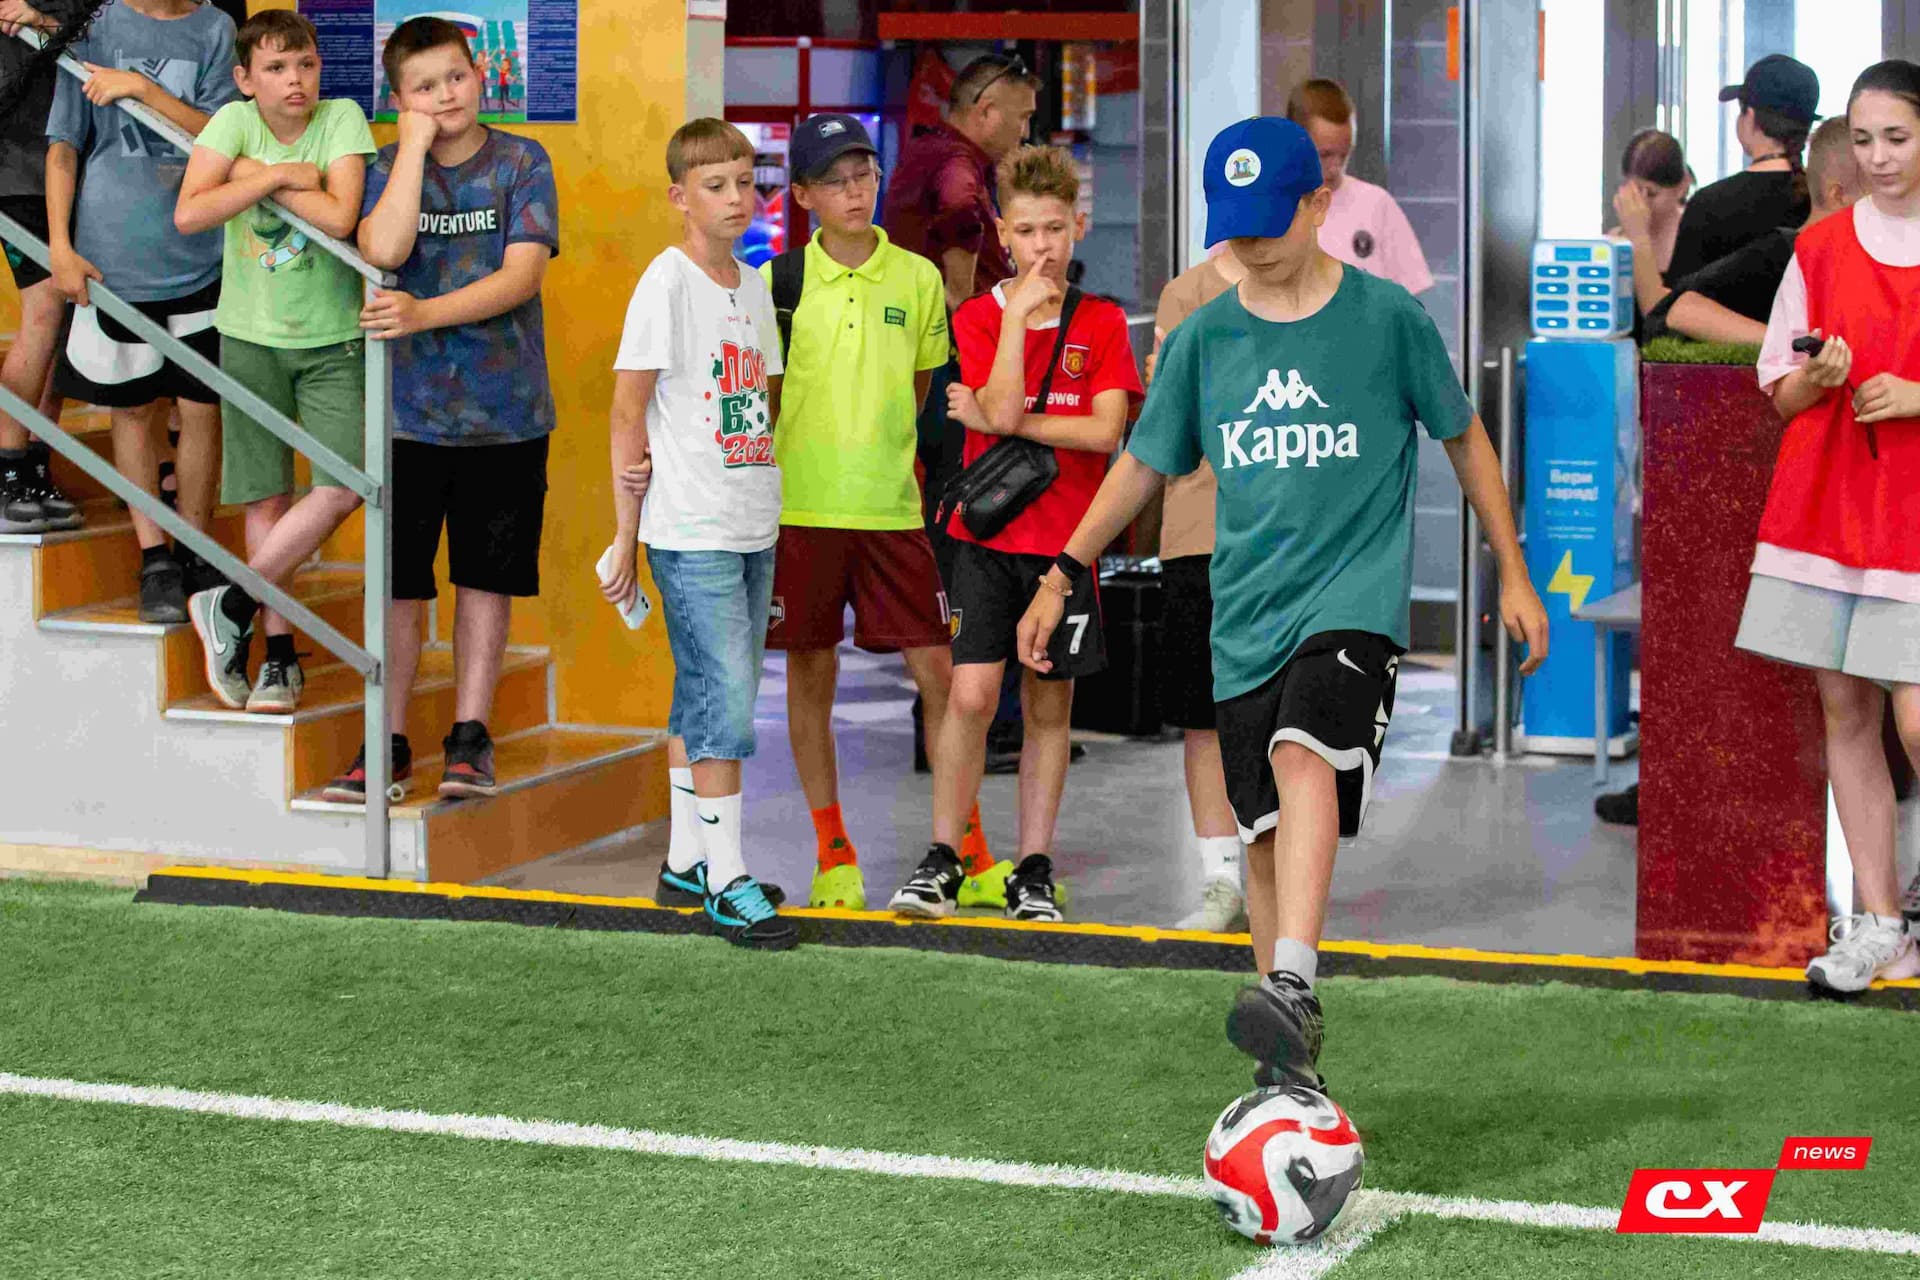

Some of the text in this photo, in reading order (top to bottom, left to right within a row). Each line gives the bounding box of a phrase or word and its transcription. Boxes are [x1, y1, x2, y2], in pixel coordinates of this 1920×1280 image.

[418, 208, 497, 235] DVENTURE
[1217, 419, 1361, 469] Kappa
[1066, 613, 1090, 655] 7
